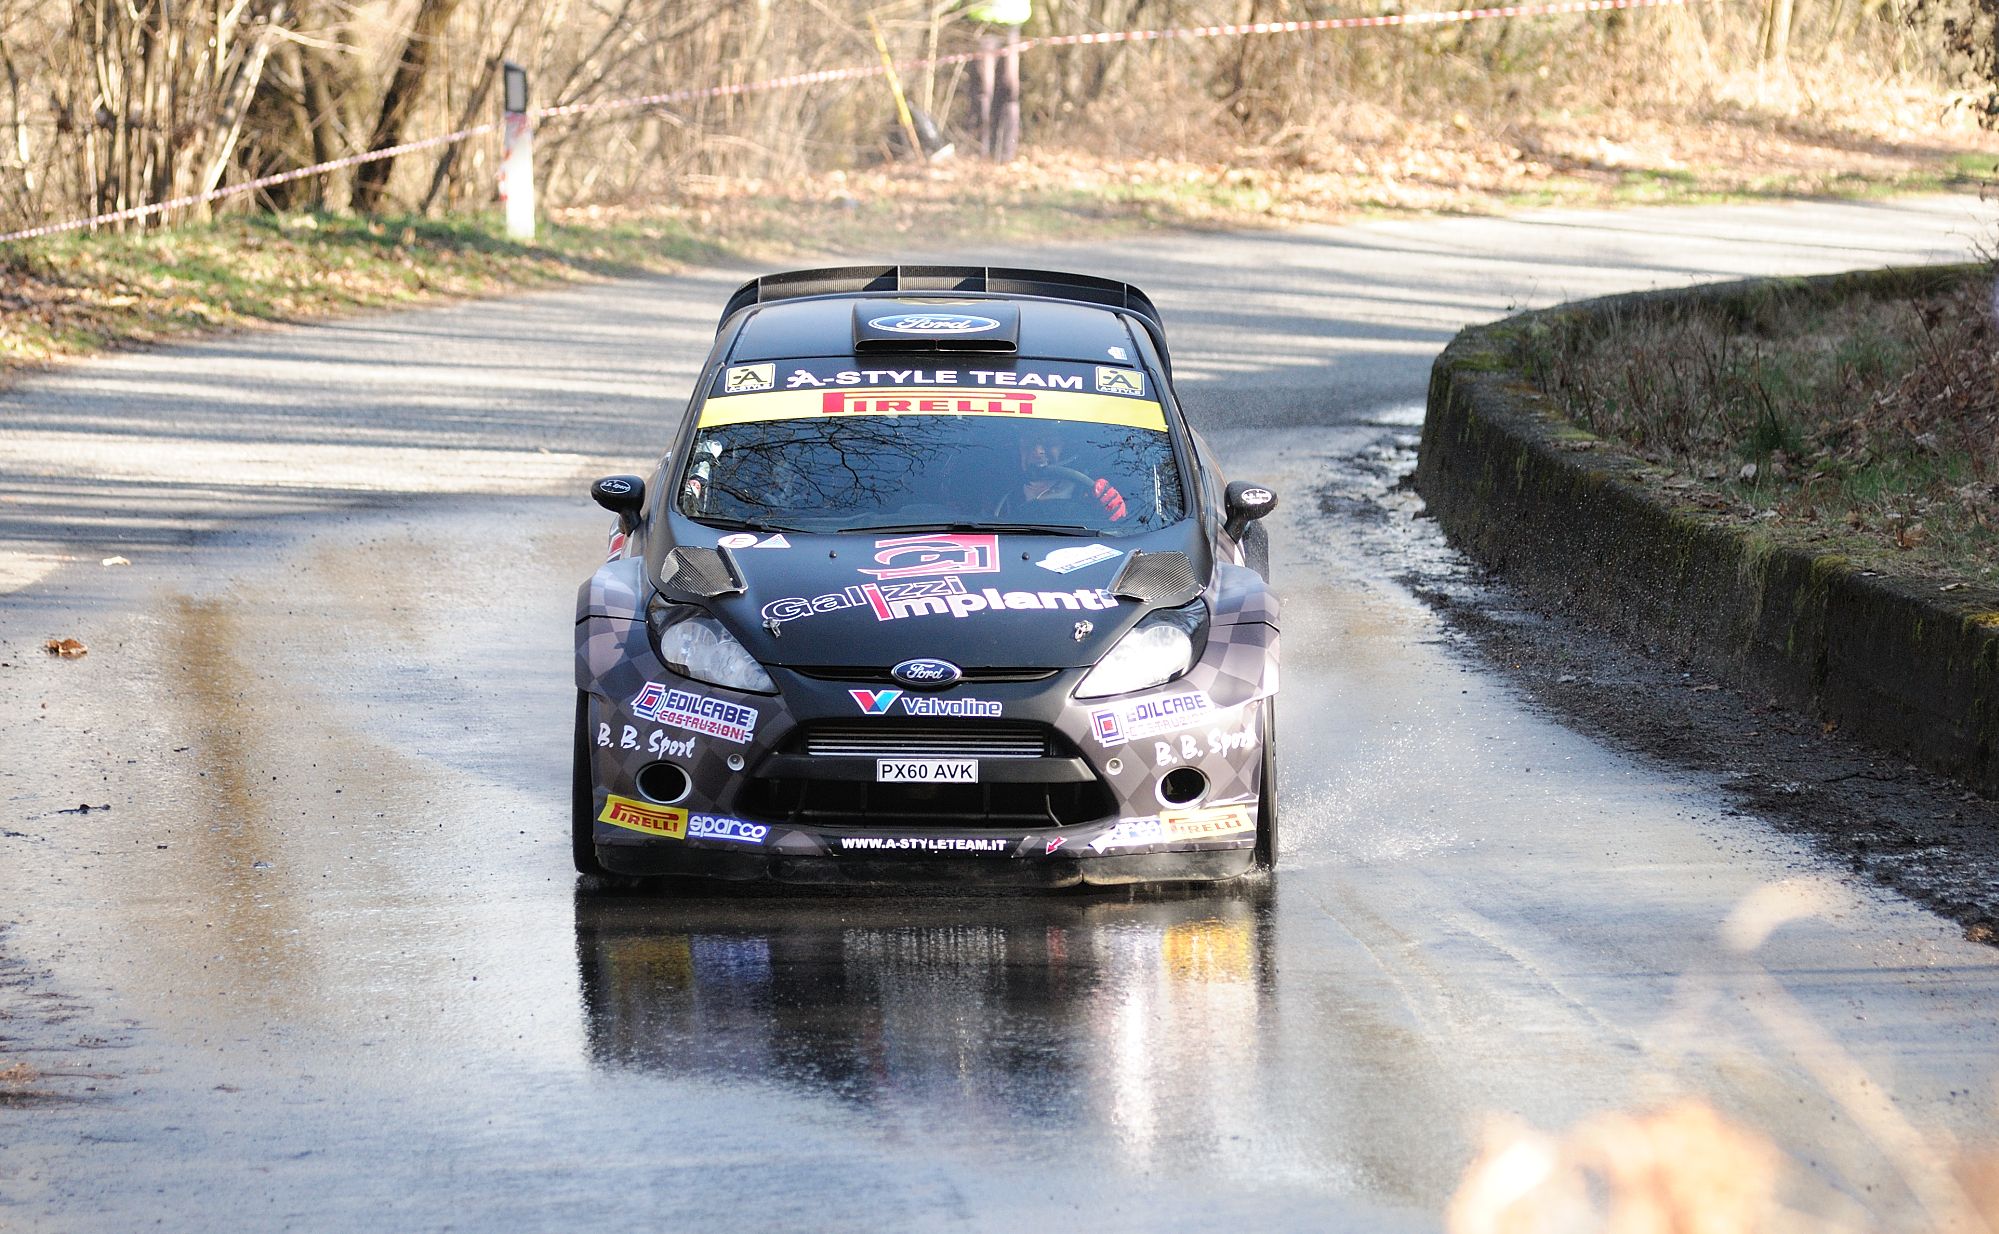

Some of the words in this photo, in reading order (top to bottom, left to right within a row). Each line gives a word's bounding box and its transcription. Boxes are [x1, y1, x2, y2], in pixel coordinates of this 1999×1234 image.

[896, 316, 972, 330] Ford
[786, 369, 958, 388] A-STYLE
[969, 371, 1083, 390] TEAM
[823, 390, 1037, 414] PIRELLI
[761, 576, 967, 622] Galizzi
[906, 662, 944, 680] Ford
[665, 692, 751, 727] EDILCABE
[901, 698, 1002, 717] Valvoline
[1126, 695, 1207, 723] EDILCABE
[658, 710, 746, 741] COSTRUZIONI
[597, 722, 614, 748] B.
[620, 725, 641, 751] B.
[648, 729, 696, 760] Sport
[1154, 741, 1178, 767] B.
[1180, 734, 1204, 760] B.
[881, 764, 928, 779] PX60
[934, 764, 973, 779] AVK
[609, 802, 679, 833] PIRELLI
[689, 815, 767, 839] sparco
[1168, 813, 1242, 834] PIRELLI
[841, 838, 1007, 851] WWW.A-STYLETEAM.IT
